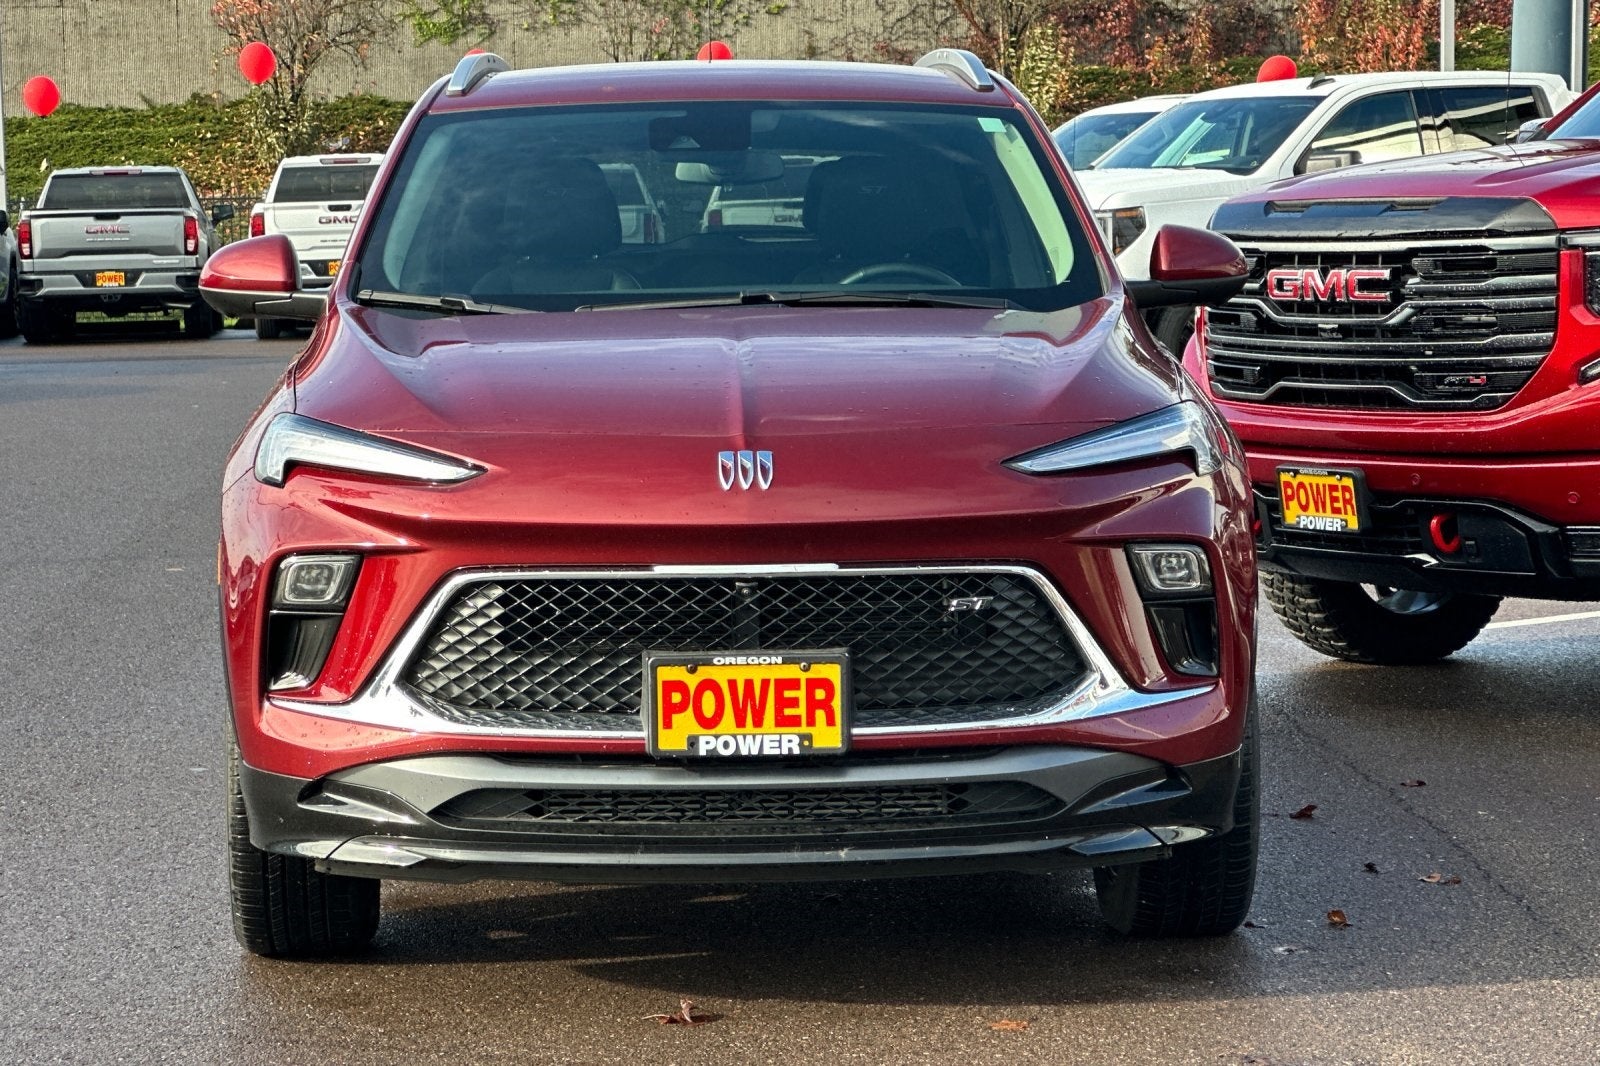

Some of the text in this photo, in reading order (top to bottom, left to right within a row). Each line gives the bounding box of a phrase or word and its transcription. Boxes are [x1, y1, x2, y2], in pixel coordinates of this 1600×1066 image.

[96, 274, 124, 284] POWER
[1267, 269, 1391, 302] GMC
[1282, 480, 1356, 517] POWER
[1300, 515, 1342, 532] POWER
[713, 656, 783, 665] OREGON
[662, 677, 836, 730] POWER
[698, 734, 801, 756] POWER
